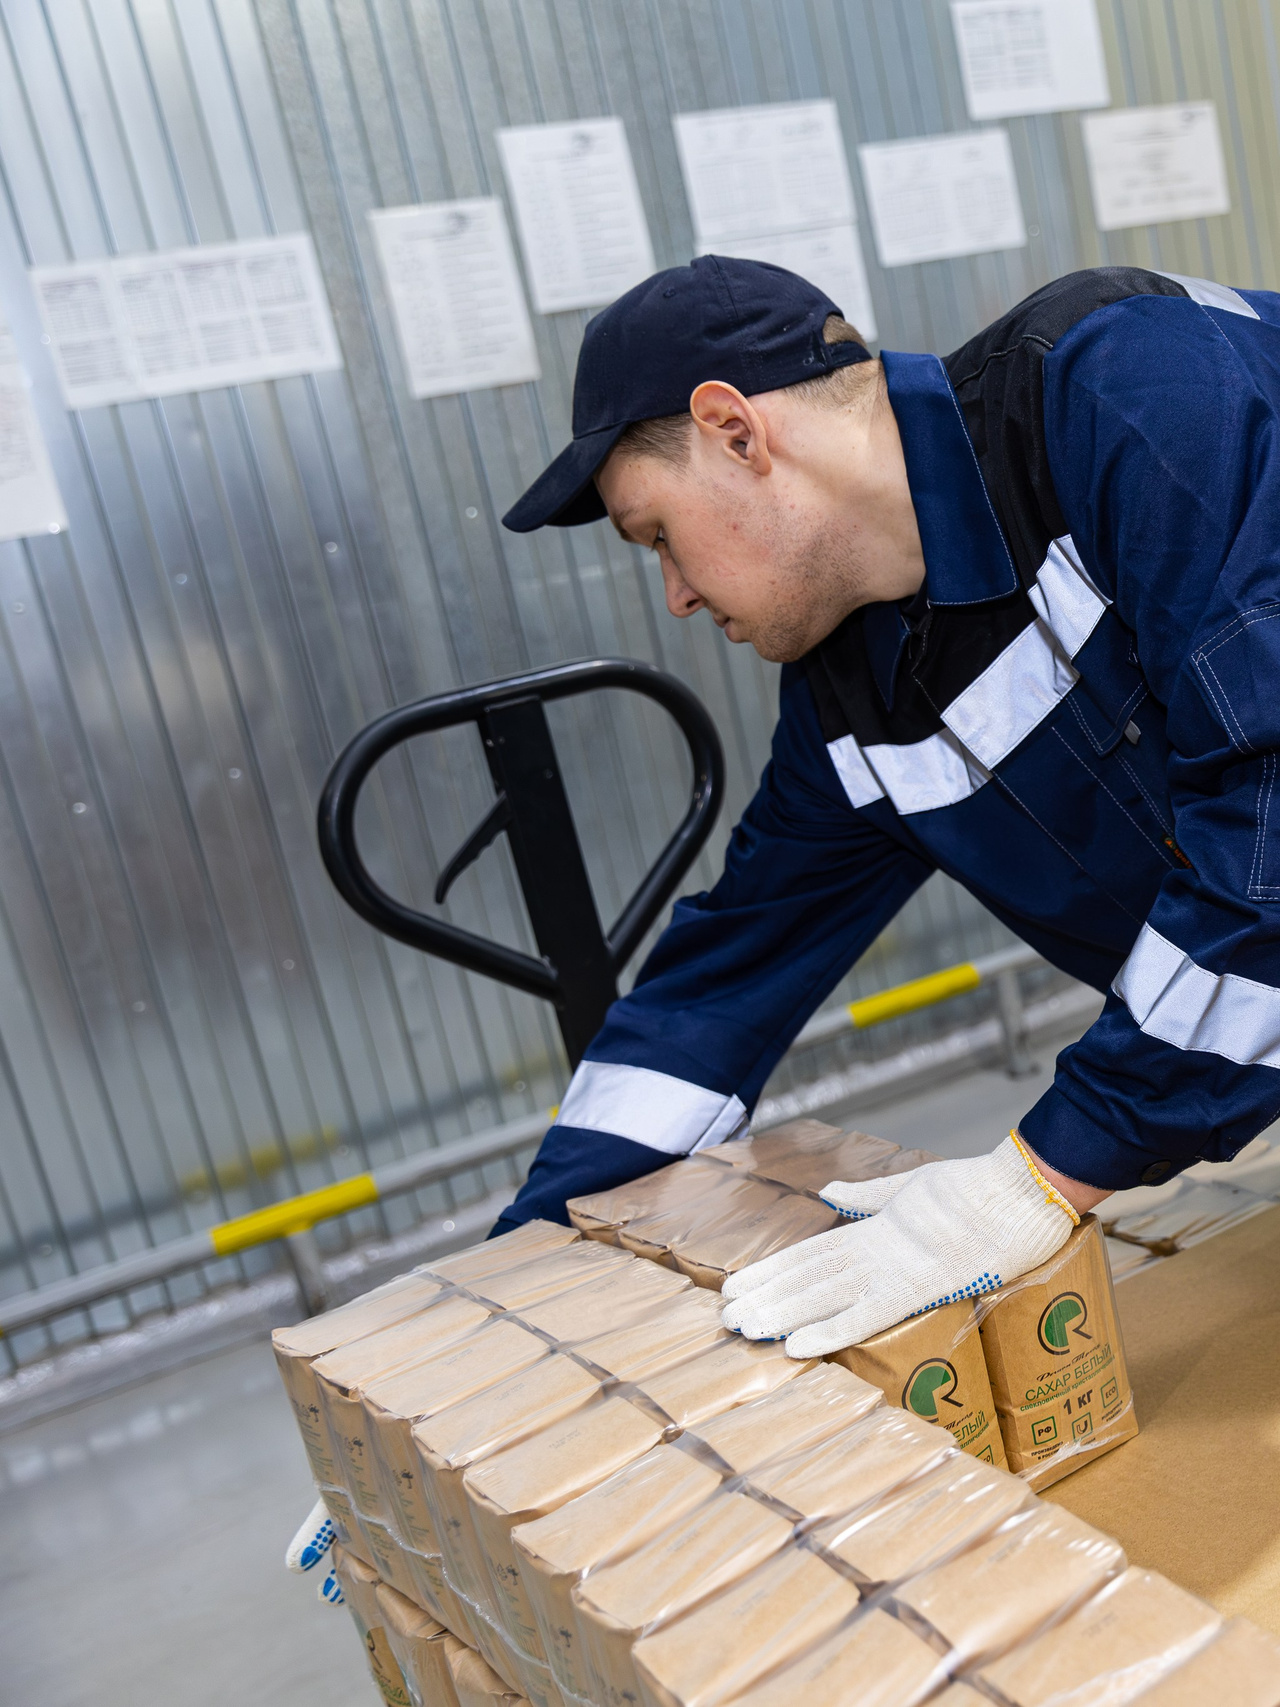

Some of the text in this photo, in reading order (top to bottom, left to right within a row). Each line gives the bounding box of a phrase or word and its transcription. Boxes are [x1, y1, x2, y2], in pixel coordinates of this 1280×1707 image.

[1025, 1343, 1112, 1401] САХАР БЕЛЫЙ
[1020, 1386, 1071, 1412] свекловичный
[1105, 1386, 1116, 1399] ECO
[1063, 1398, 1072, 1415] 1
[952, 1410, 986, 1442] ЕЛЫЙ
[1037, 1425, 1052, 1437] РФ
